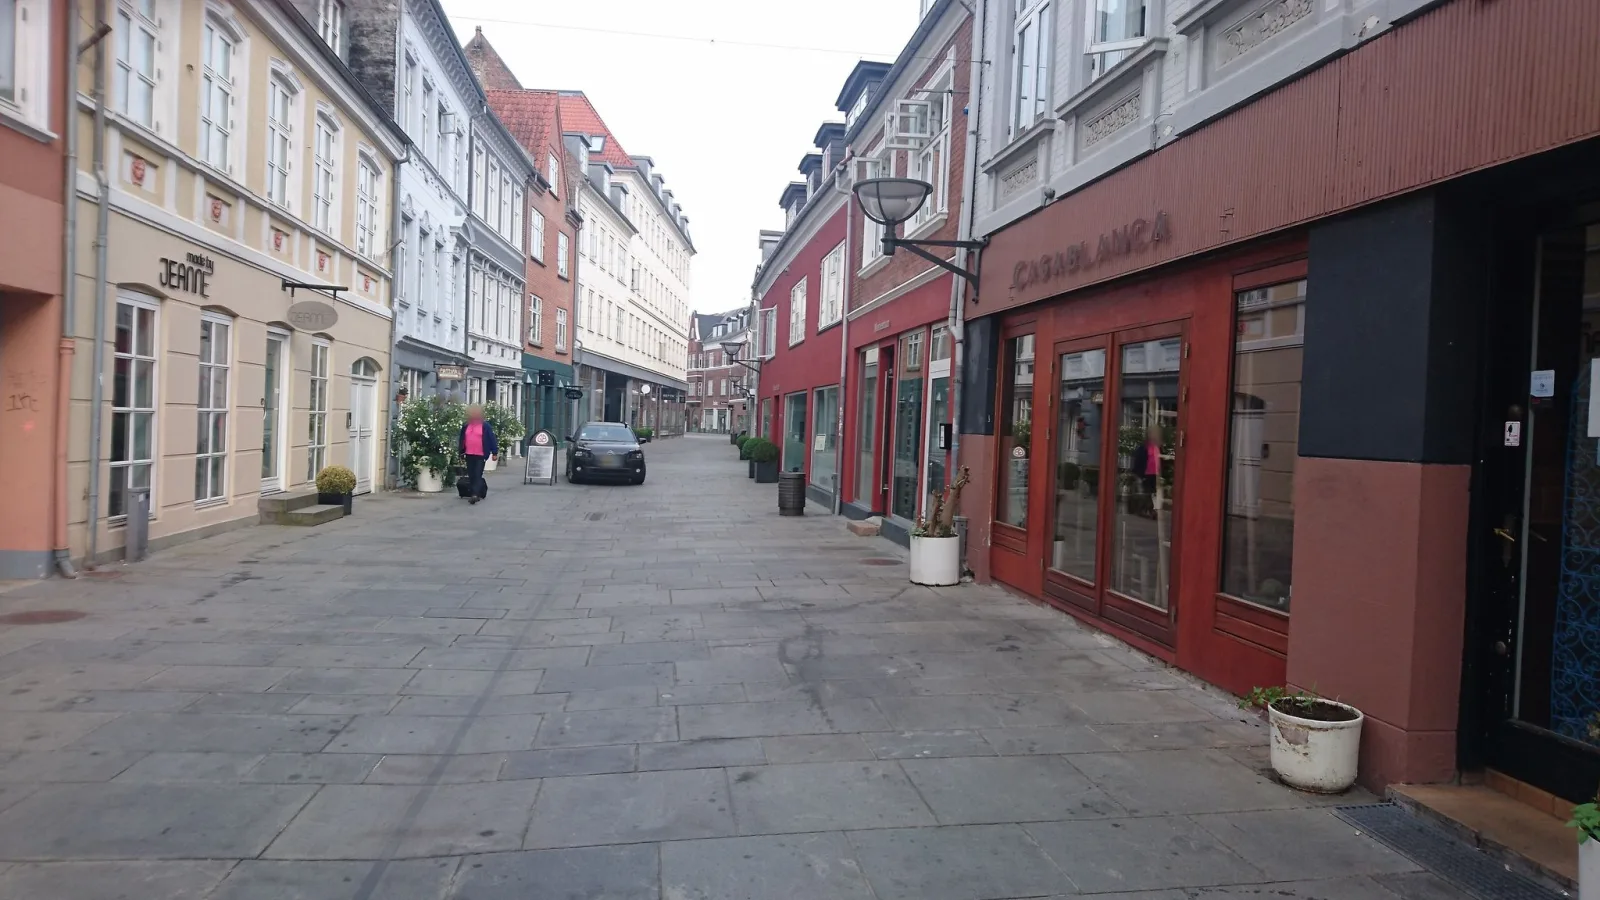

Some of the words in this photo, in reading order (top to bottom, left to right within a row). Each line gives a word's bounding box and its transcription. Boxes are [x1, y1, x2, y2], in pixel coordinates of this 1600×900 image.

[186, 252, 205, 267] made
[205, 256, 214, 276] by
[1013, 210, 1172, 291] CASABLANCA
[159, 257, 210, 299] JEANNE
